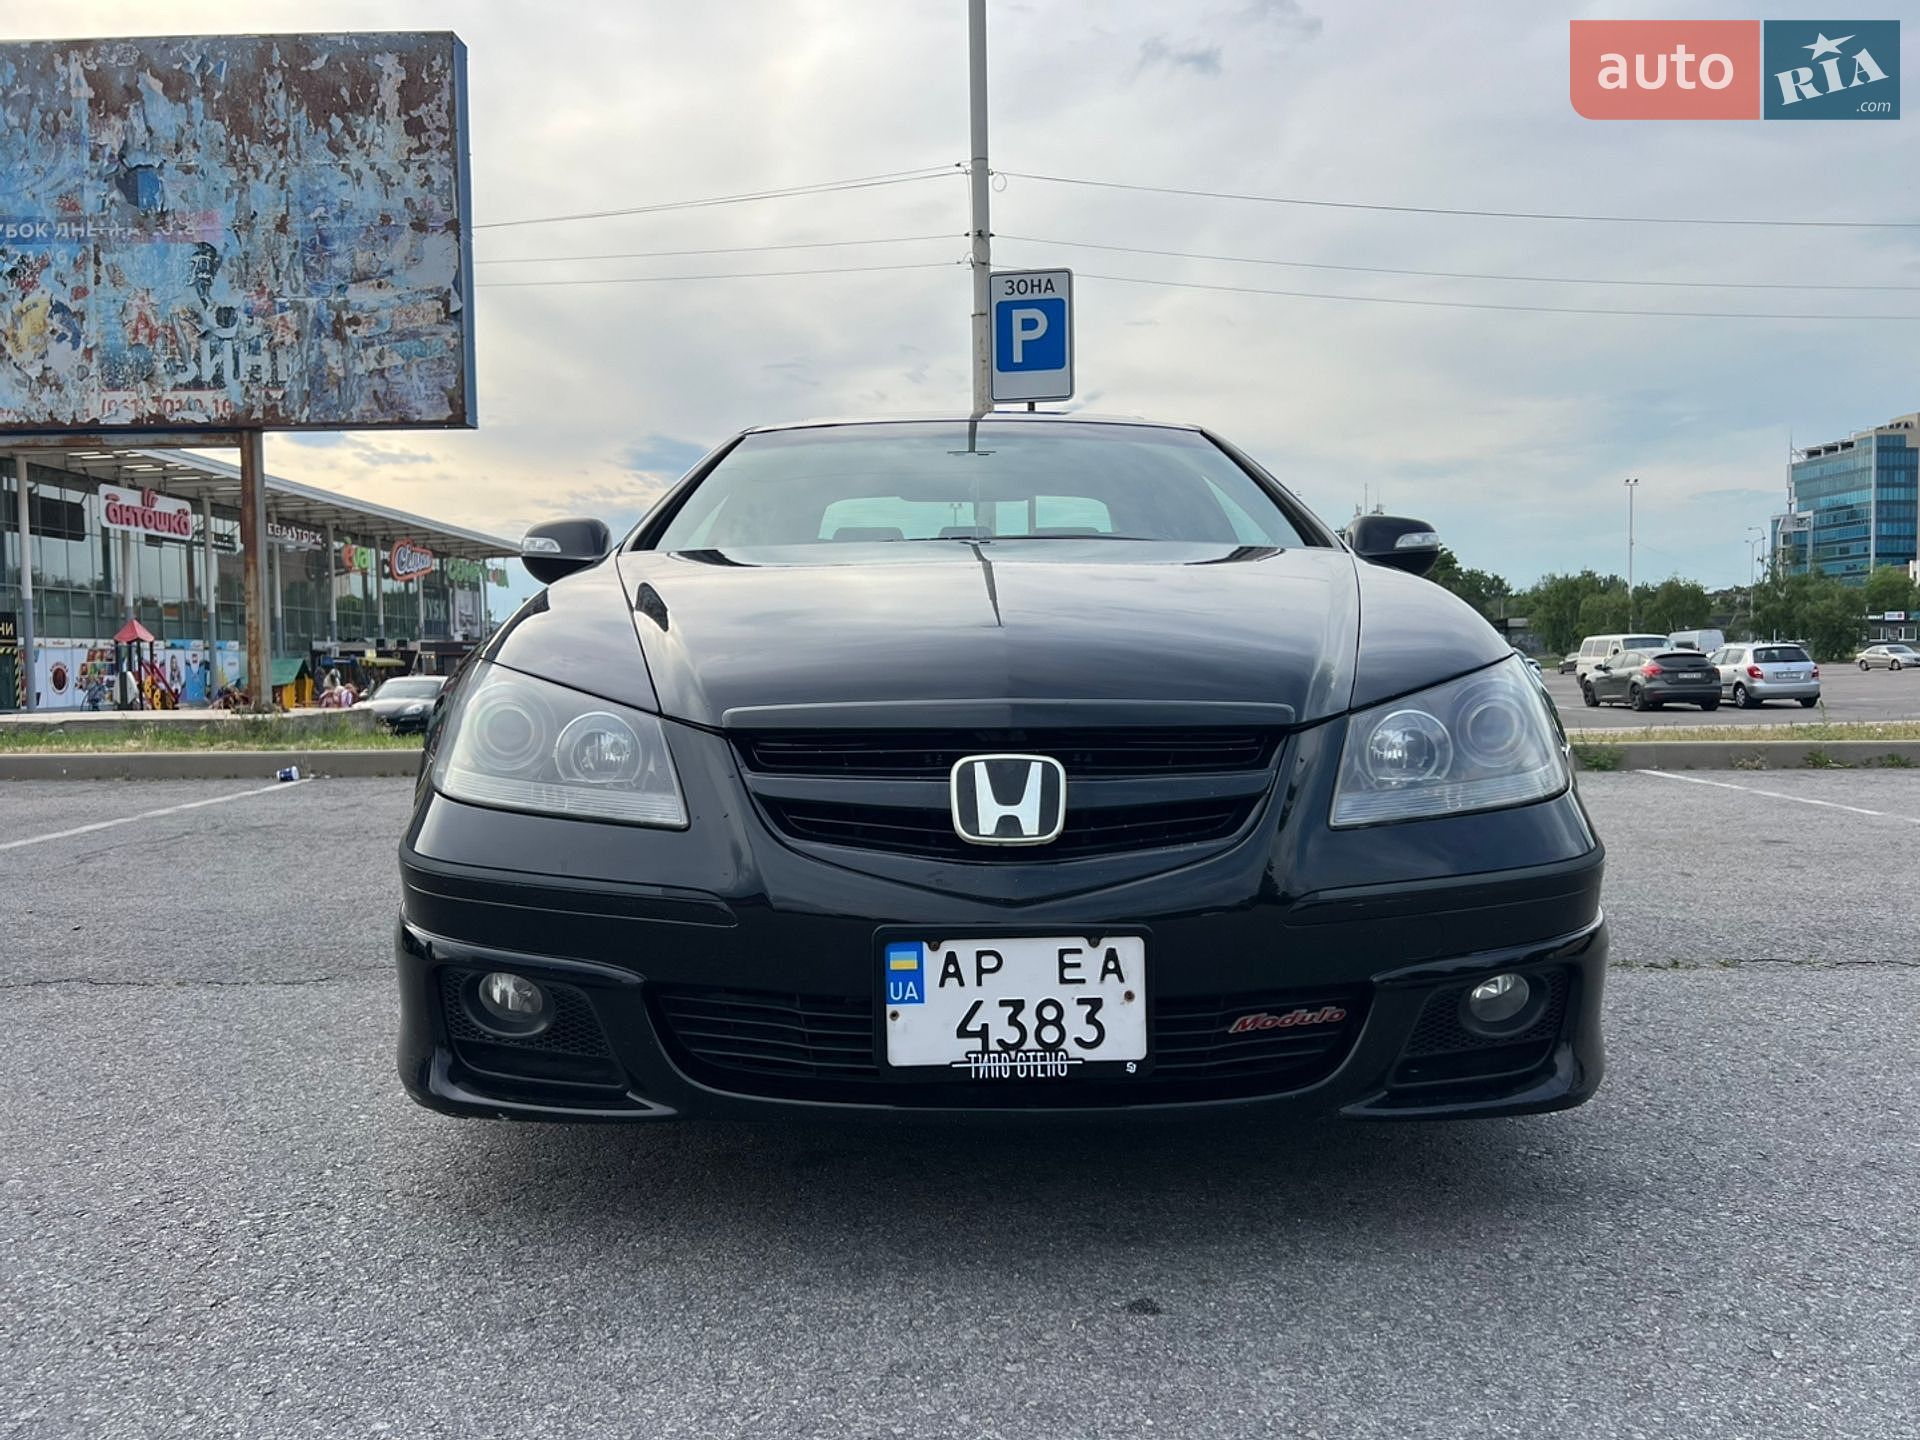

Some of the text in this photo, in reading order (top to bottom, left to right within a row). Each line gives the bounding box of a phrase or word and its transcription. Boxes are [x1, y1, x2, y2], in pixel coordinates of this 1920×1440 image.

[0, 223, 48, 238] БОК
[1004, 279, 1056, 296] ЗОНА
[1012, 308, 1049, 364] P
[938, 947, 1126, 988] AP EA
[890, 981, 919, 1001] UA
[956, 998, 1106, 1051] 4383
[1228, 1006, 1347, 1034] Modulo
